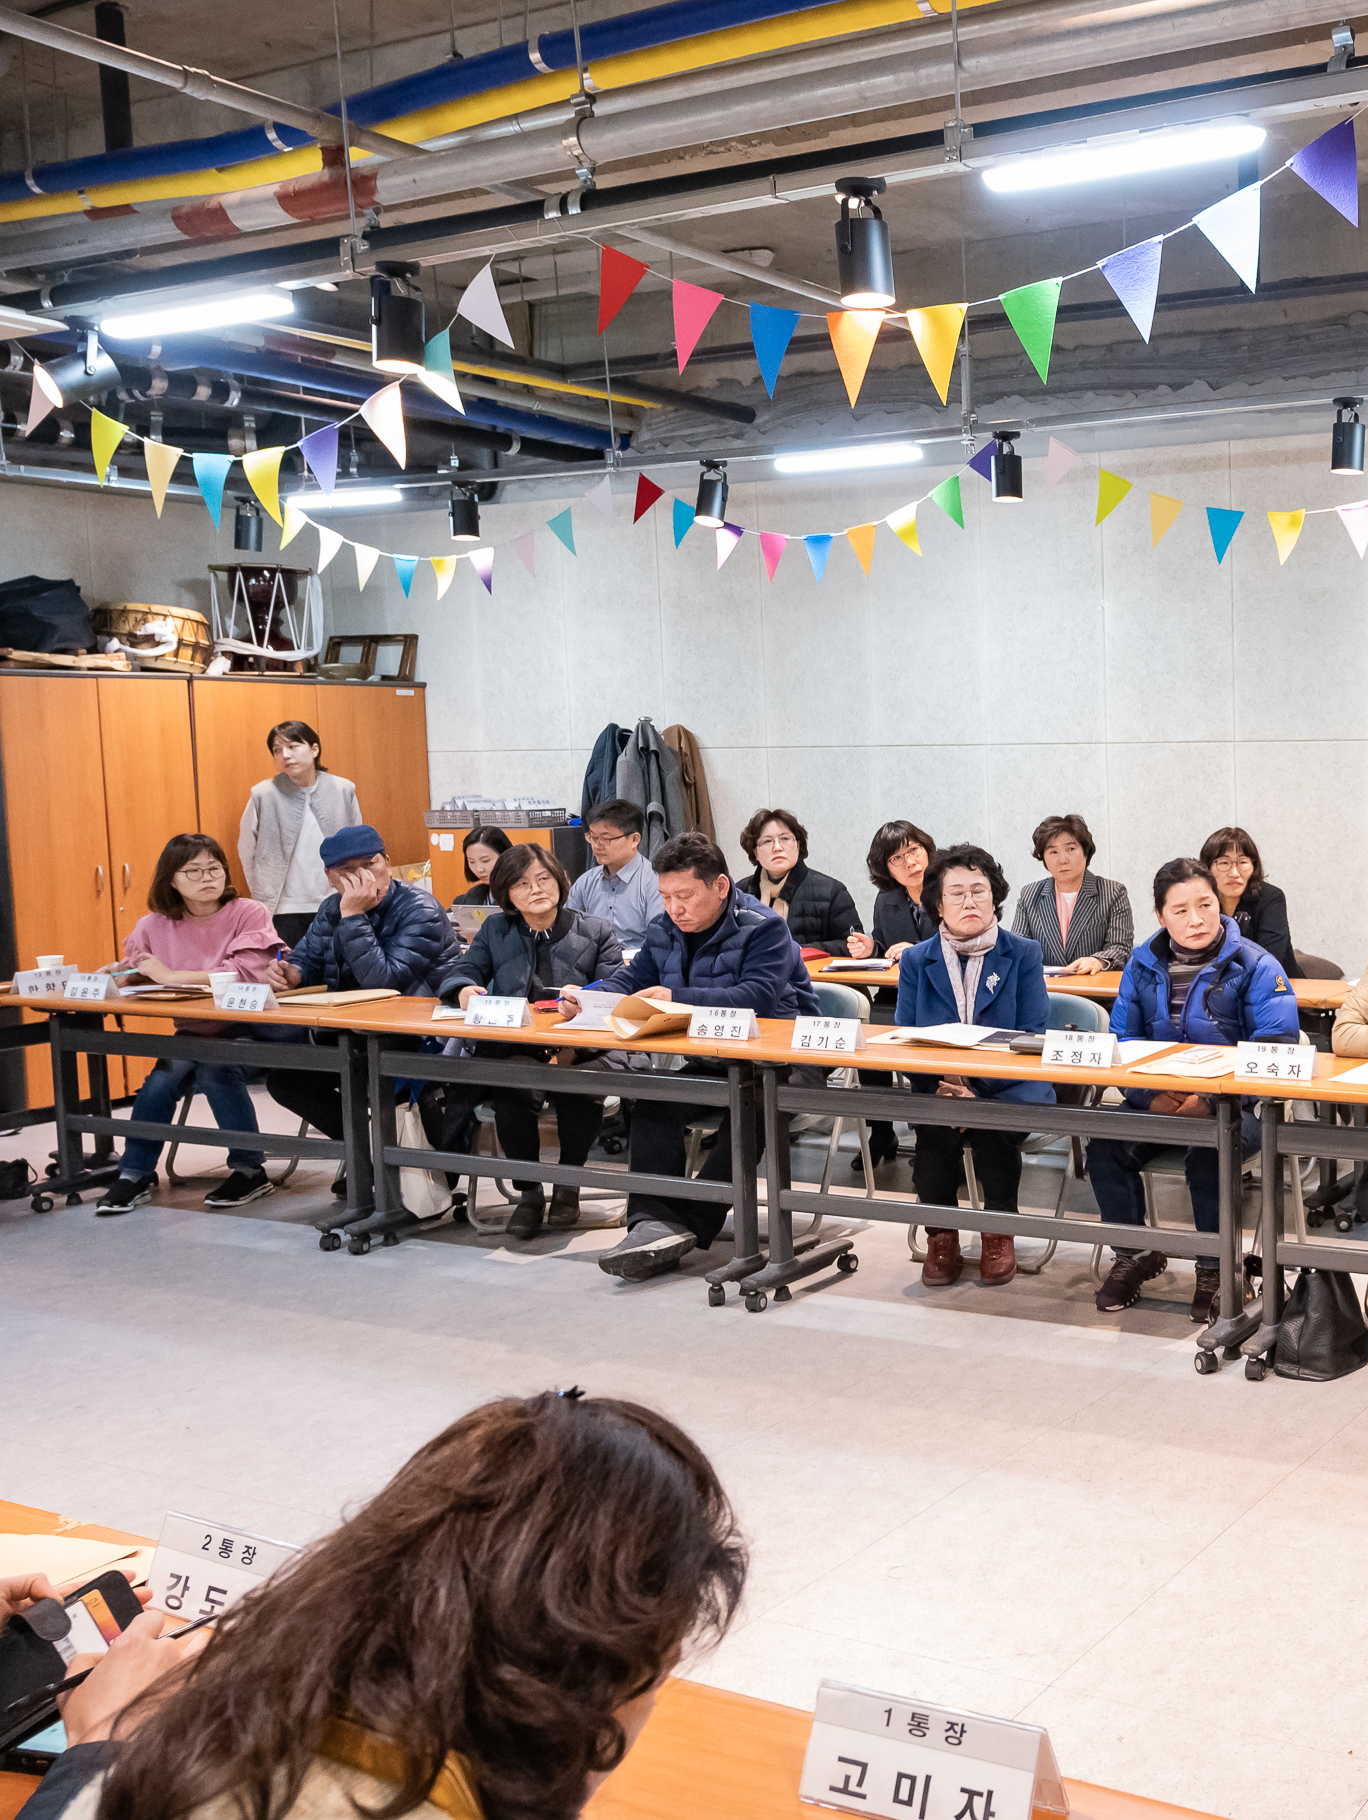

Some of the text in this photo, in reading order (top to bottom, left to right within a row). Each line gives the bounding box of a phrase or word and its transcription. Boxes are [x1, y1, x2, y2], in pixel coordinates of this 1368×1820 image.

[709, 1009, 737, 1018] 16통장
[697, 1023, 742, 1038] 송영진
[812, 1020, 841, 1029] 17통장
[800, 1034, 847, 1050] 김기순
[1064, 1034, 1095, 1043] 18통장
[1050, 1050, 1103, 1065] 조정자
[1256, 1045, 1296, 1055] 19통장
[1245, 1061, 1302, 1078] 오숙자
[201, 1534, 257, 1566] 2통장
[164, 1572, 228, 1616] 강도
[883, 1707, 967, 1746] 1통장
[829, 1755, 996, 1820] 고미자
